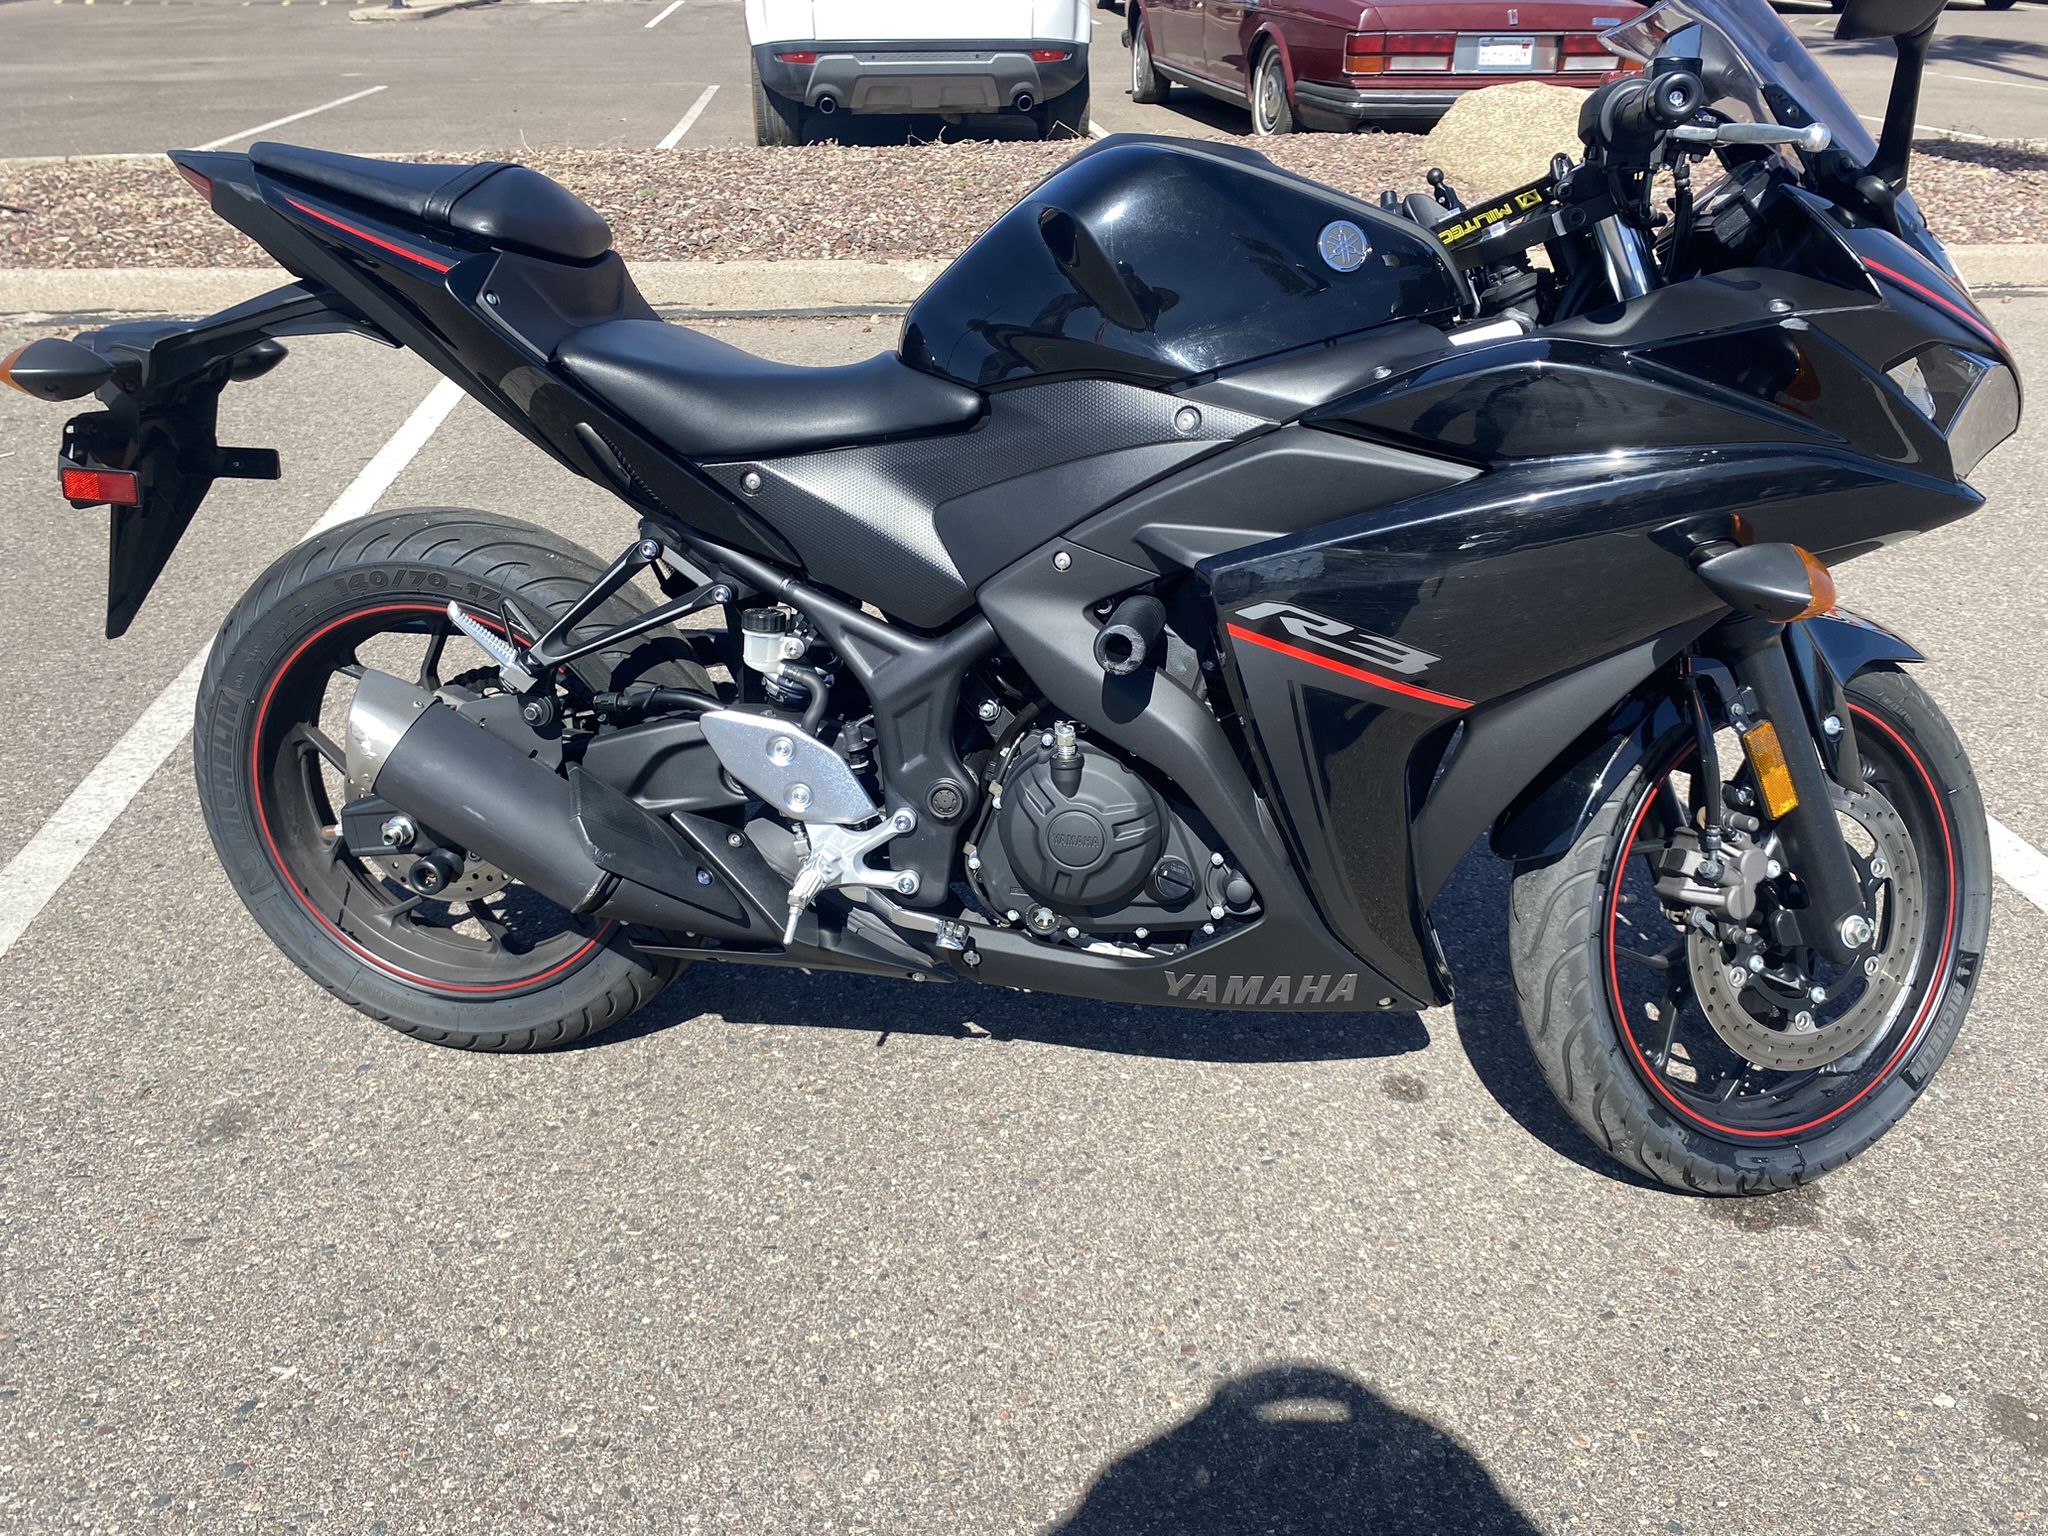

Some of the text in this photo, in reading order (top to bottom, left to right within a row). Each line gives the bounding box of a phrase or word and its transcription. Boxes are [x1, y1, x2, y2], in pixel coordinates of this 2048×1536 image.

[1438, 203, 1513, 244] MILITEC
[334, 568, 501, 602] 140/70-17
[1235, 602, 1441, 674] R3
[1052, 832, 1100, 848] YAMAHA
[1164, 970, 1358, 1005] YAMAHA
[1909, 981, 1966, 1082] MICHELIN
